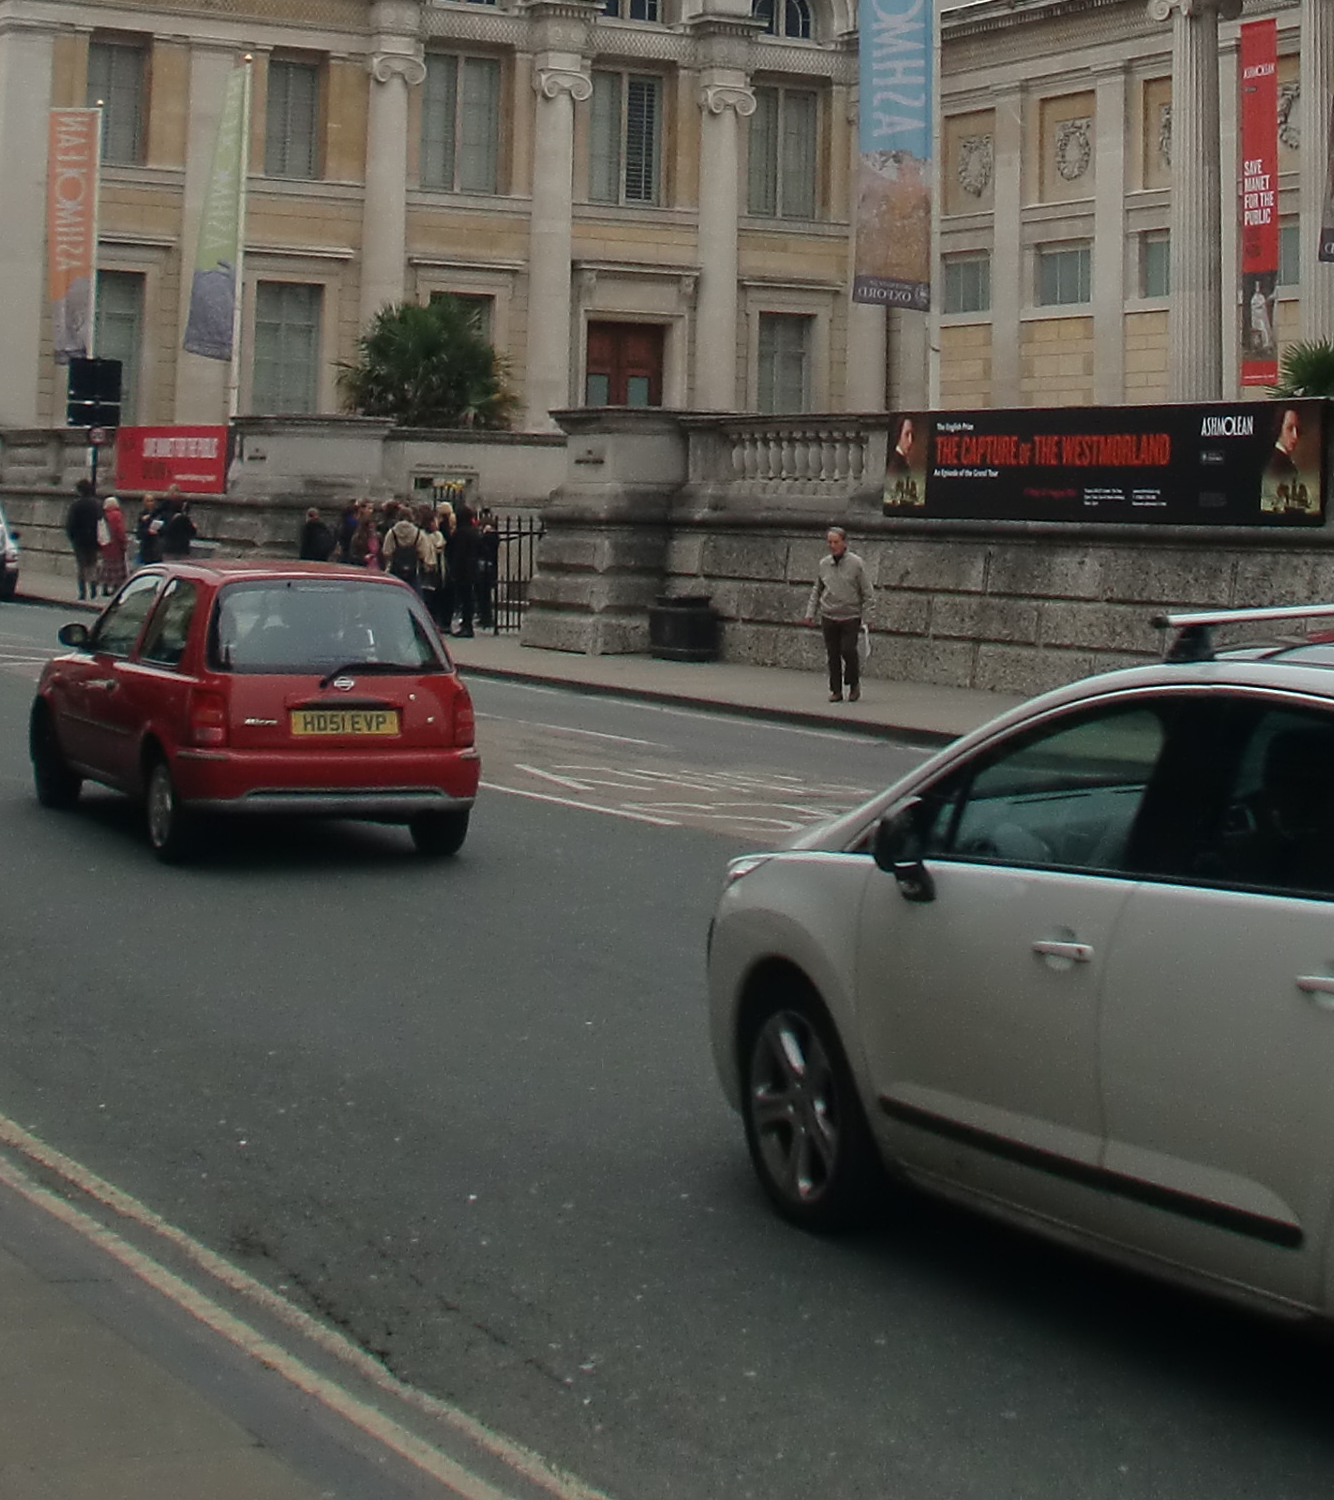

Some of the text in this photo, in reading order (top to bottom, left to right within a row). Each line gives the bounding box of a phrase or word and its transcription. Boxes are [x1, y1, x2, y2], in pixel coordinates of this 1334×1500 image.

[1243, 63, 1275, 79] ASHMOLEAN
[1244, 159, 1262, 176] SAVE
[1244, 175, 1270, 192] MANET
[1244, 190, 1274, 209] FOR THE
[1244, 207, 1271, 226] PUBLIC
[1201, 416, 1254, 436] ASHMOLEAN
[935, 436, 959, 465] THE
[961, 435, 1018, 464] CAPTURE
[1033, 434, 1059, 465] THE
[1061, 433, 1171, 466] WESTMORLAND
[350, 714, 387, 731] EVP
